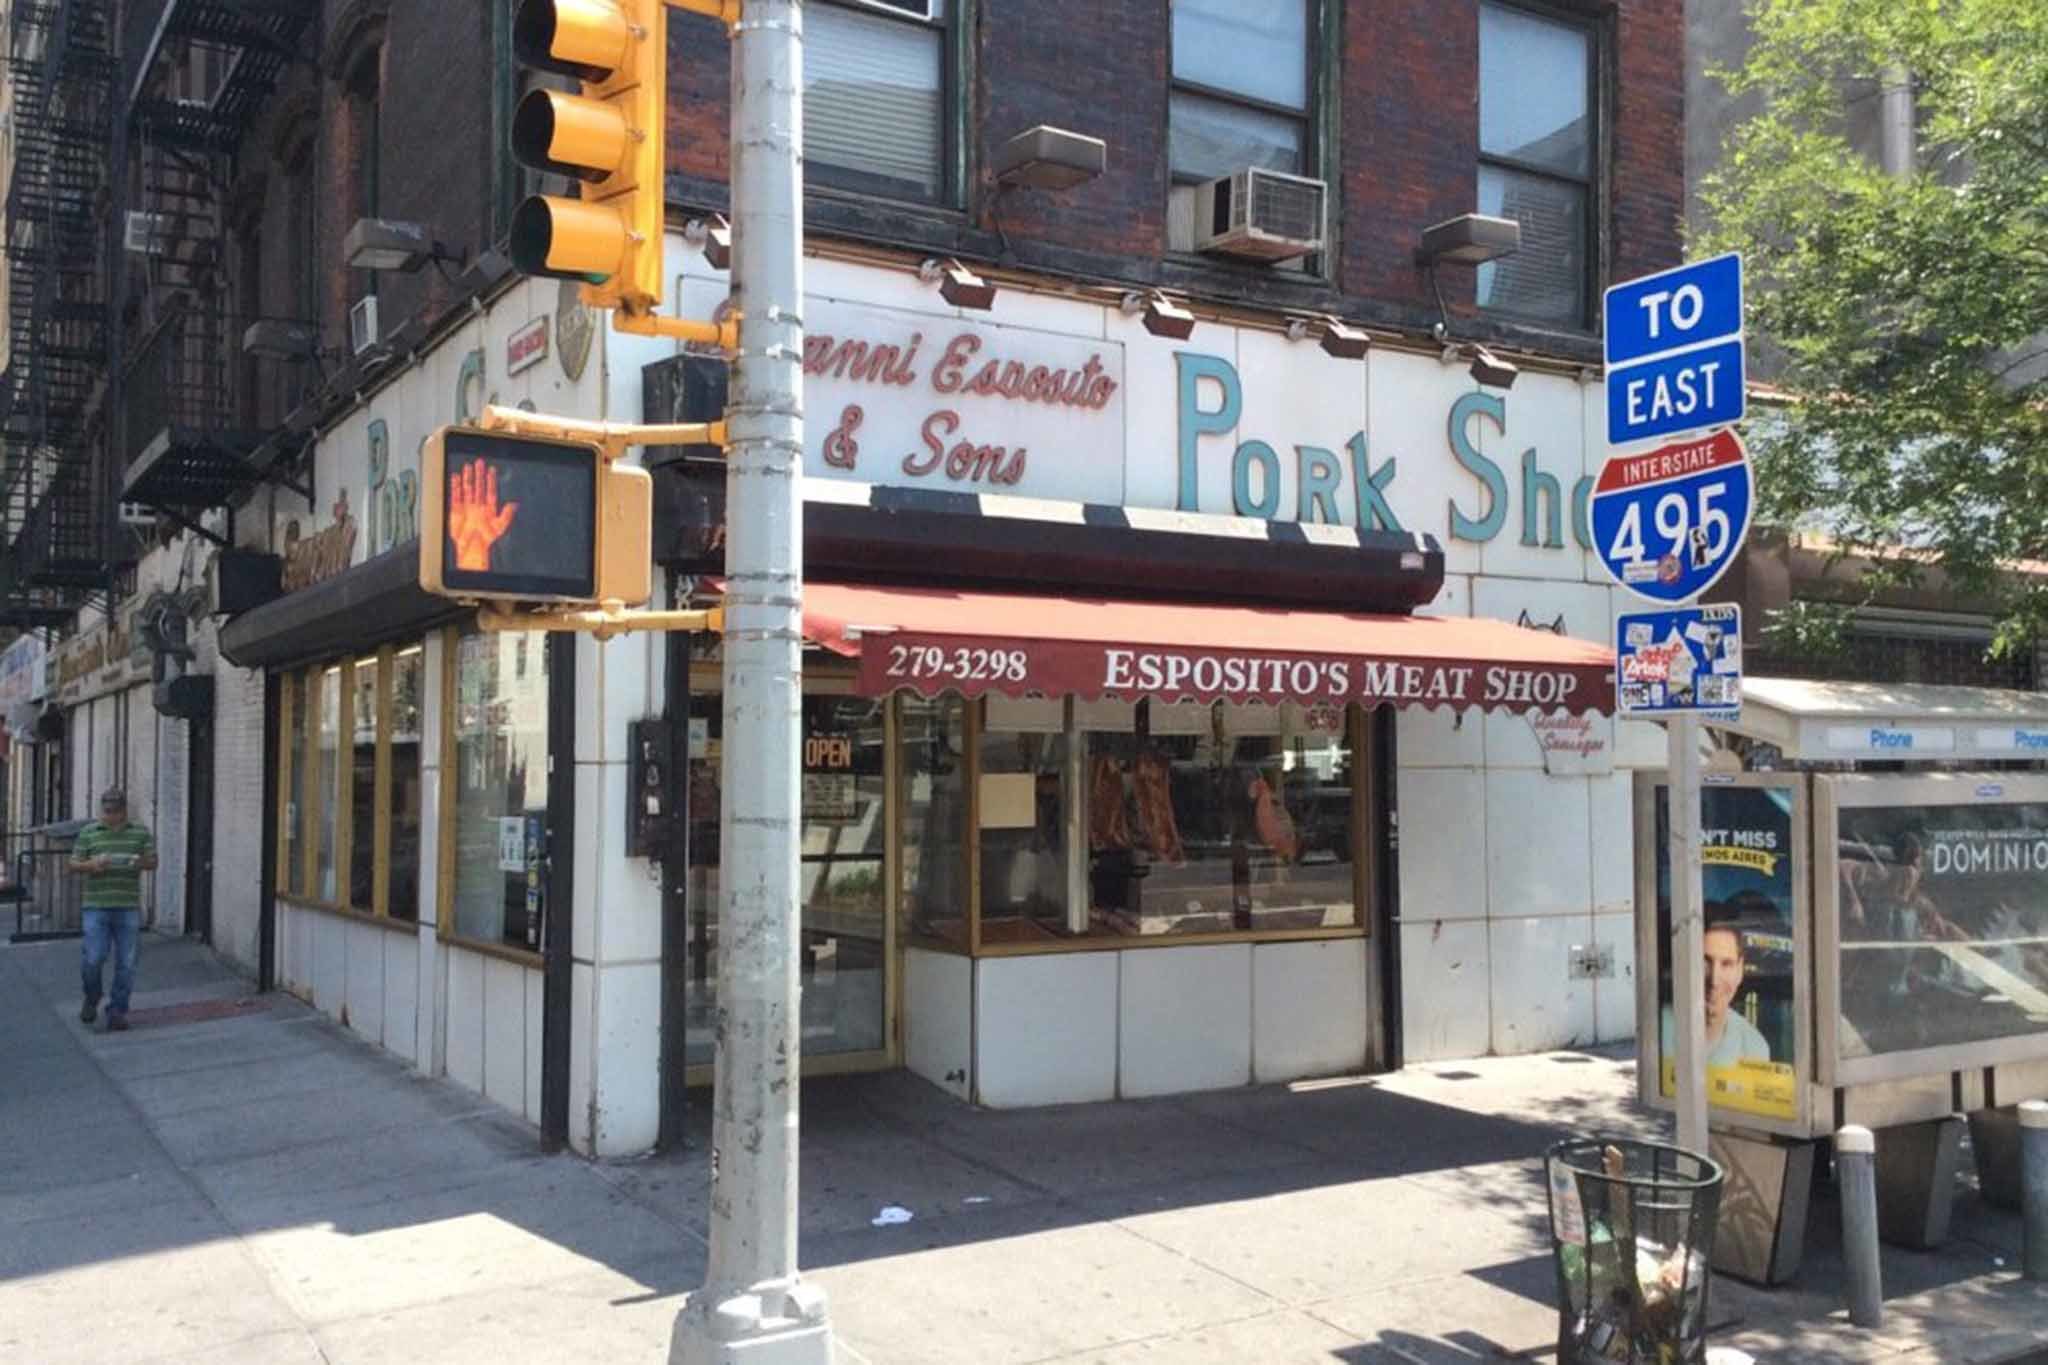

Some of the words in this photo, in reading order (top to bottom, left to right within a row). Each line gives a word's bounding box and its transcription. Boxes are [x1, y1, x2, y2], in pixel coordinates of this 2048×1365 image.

[1639, 284, 1704, 339] TO
[803, 332, 923, 386] anni
[1627, 362, 1720, 426] EAST
[822, 404, 864, 470] &
[902, 410, 1028, 485] Sons
[1623, 443, 1716, 484] INTERSTATE
[1609, 481, 1731, 568] 495
[887, 645, 1028, 681] 279-3298
[1103, 649, 1349, 696] ESPOSITO'S
[1363, 661, 1472, 700] MEAT
[1484, 667, 1578, 703] SHOP
[805, 737, 851, 768] OPEN
[1870, 729, 1913, 748] Phone
[1699, 828, 1729, 846] N'T
[1733, 829, 1777, 849] MISS
